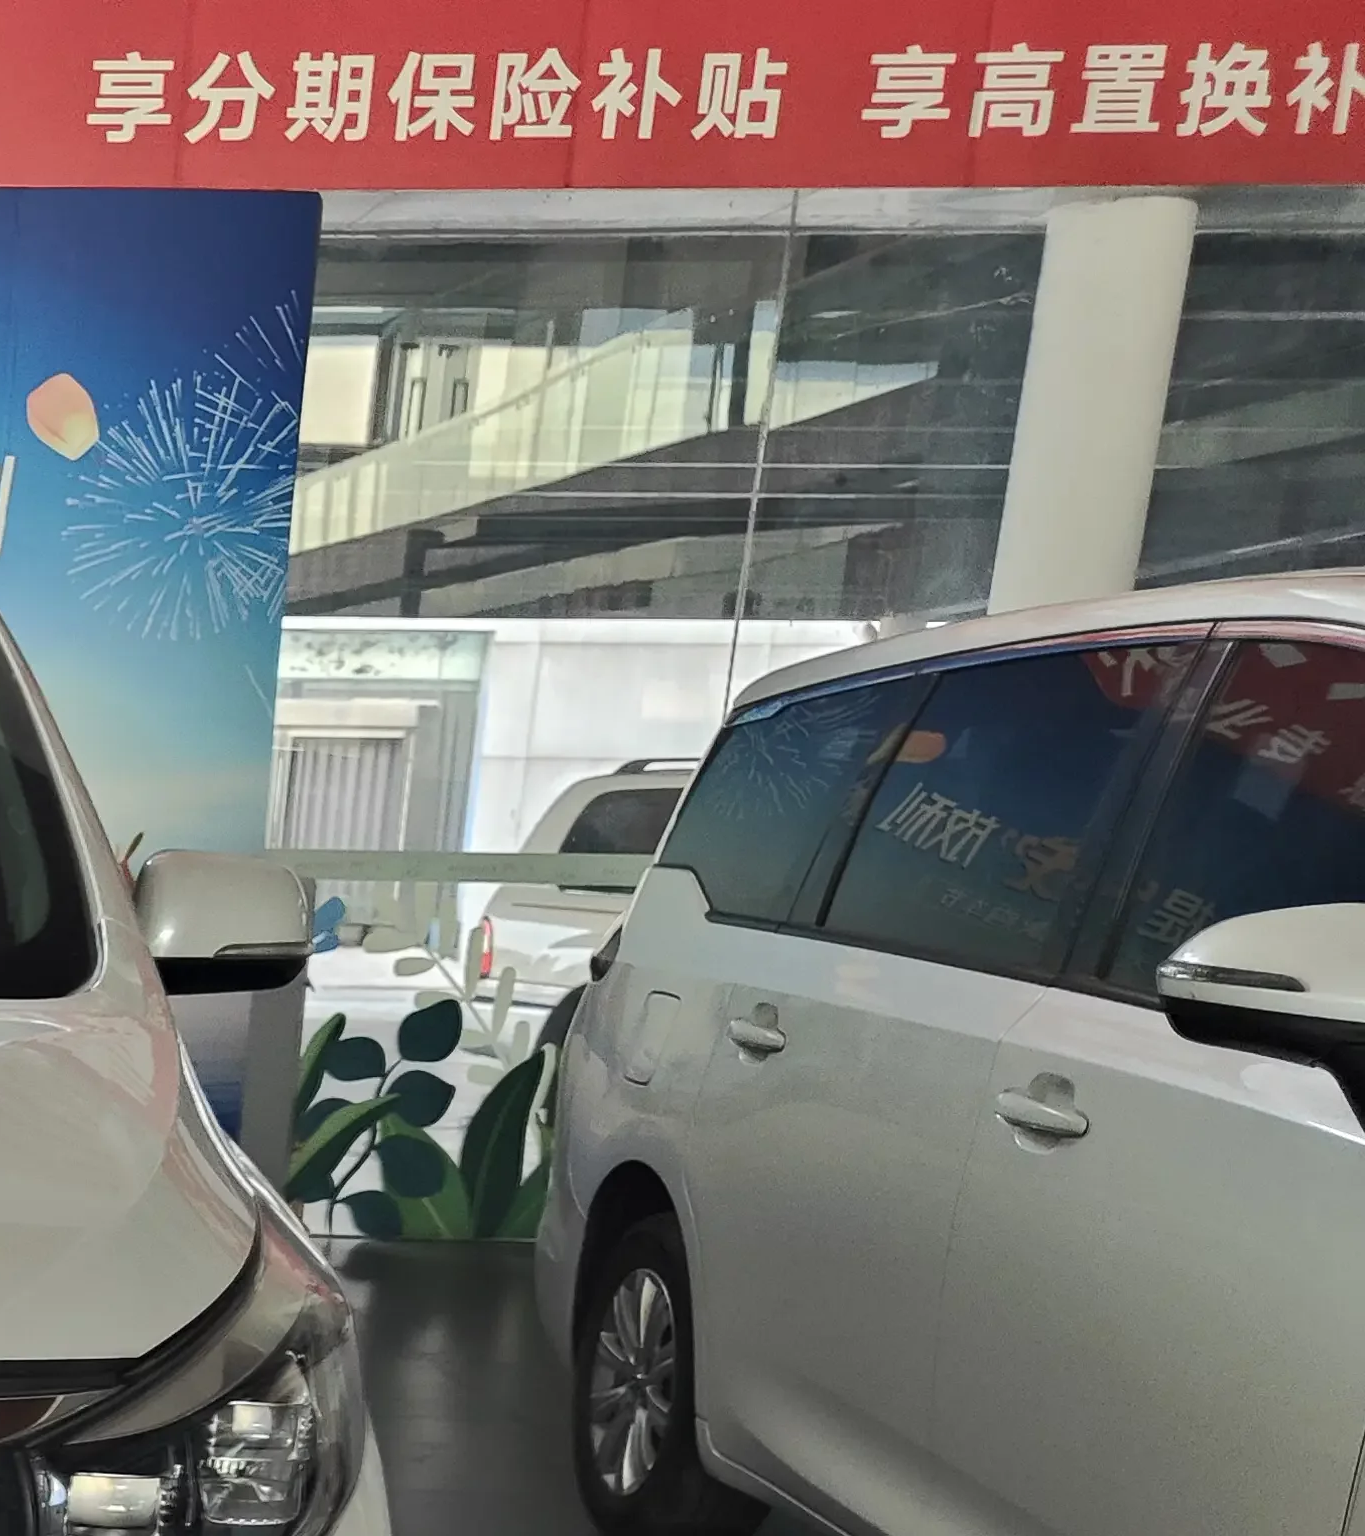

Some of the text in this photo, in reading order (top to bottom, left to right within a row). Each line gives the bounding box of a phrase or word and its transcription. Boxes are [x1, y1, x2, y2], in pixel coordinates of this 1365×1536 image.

[85, 46, 789, 144] 享分期保险补贴
[860, 41, 1365, 138] 享高置换补
